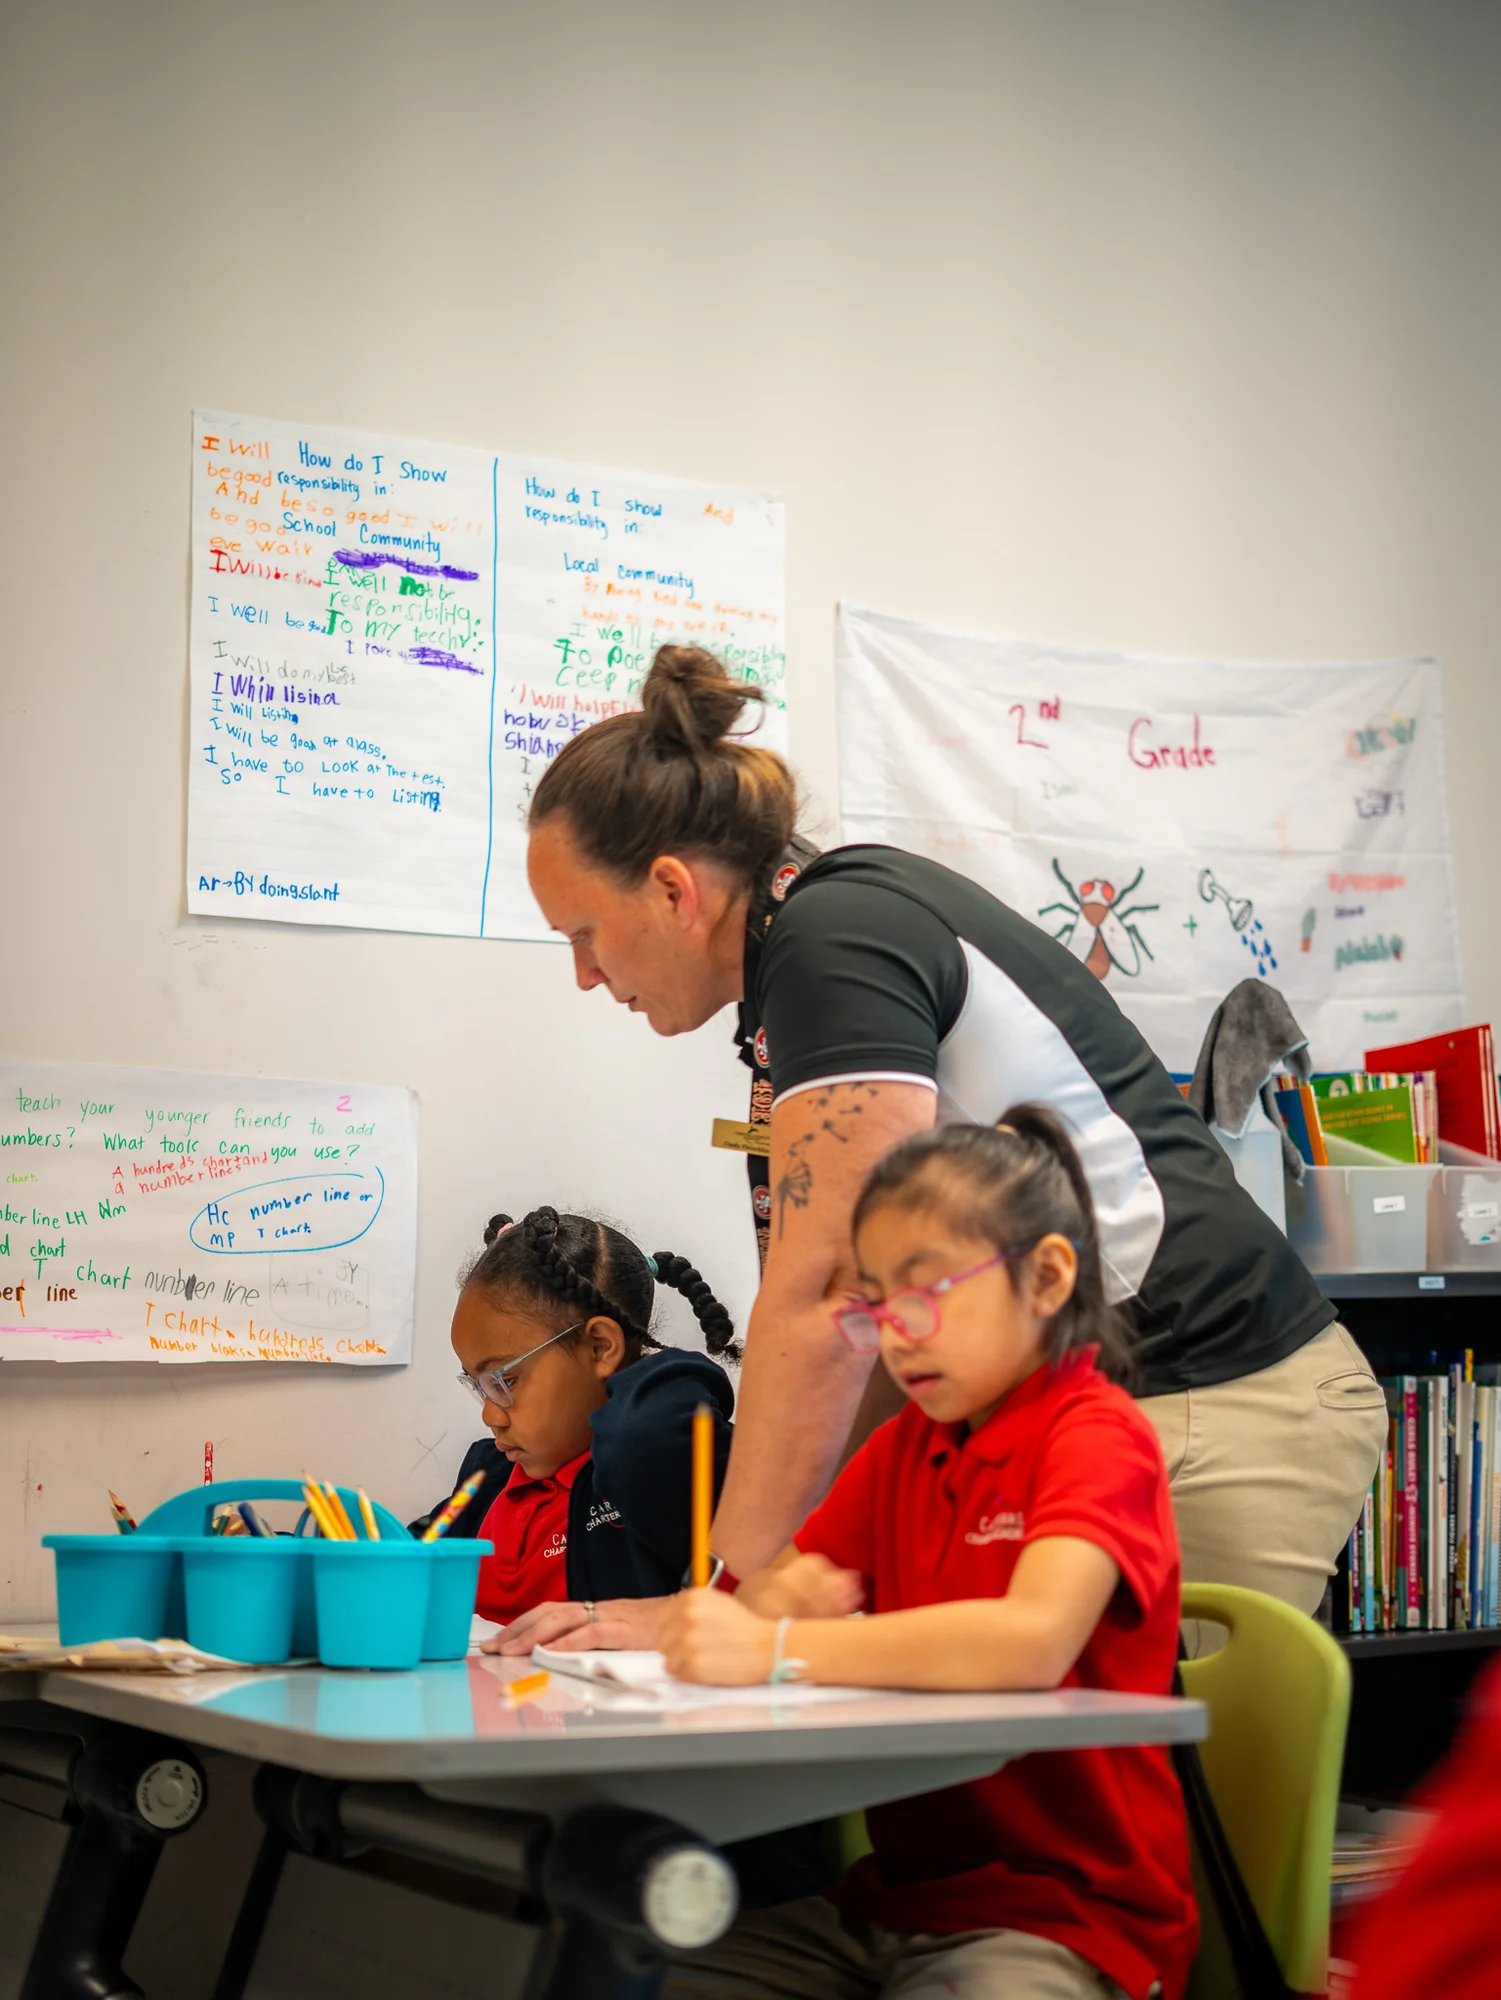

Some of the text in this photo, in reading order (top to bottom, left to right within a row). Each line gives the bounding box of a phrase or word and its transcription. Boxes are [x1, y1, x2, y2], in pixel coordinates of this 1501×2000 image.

[201, 436, 220, 451] I
[298, 440, 332, 468] How
[343, 453, 364, 471] do
[371, 455, 385, 475] I
[276, 470, 360, 502] responsibility
[525, 476, 556, 499] How
[566, 488, 581, 504] do
[591, 491, 600, 507] I
[282, 511, 337, 537] School
[563, 552, 599, 574] Local
[208, 595, 219, 613] I
[212, 640, 228, 658] I
[211, 672, 225, 695] I
[211, 698, 224, 713] I
[209, 716, 223, 731] I
[260, 729, 279, 747] be
[323, 735, 339, 749] at
[1127, 714, 1217, 770] Grade
[203, 744, 219, 765] I
[230, 750, 268, 773] have
[275, 775, 292, 796] I
[312, 781, 349, 799] have
[15, 1087, 377, 1138] teach your younger friends to add
[102, 1132, 147, 1151] What
[218, 1140, 251, 1154] can
[270, 1147, 298, 1165] you
[313, 1144, 362, 1166] use?
[112, 1166, 125, 1180] A
[250, 1192, 313, 1221] number
[323, 1187, 351, 1203] line
[359, 1193, 374, 1203] or
[32, 1208, 60, 1230] line
[30, 1237, 67, 1258] chart
[33, 1257, 132, 1290] T chart
[47, 1284, 79, 1302] line
[586, 1511, 621, 1531] CHARTER
